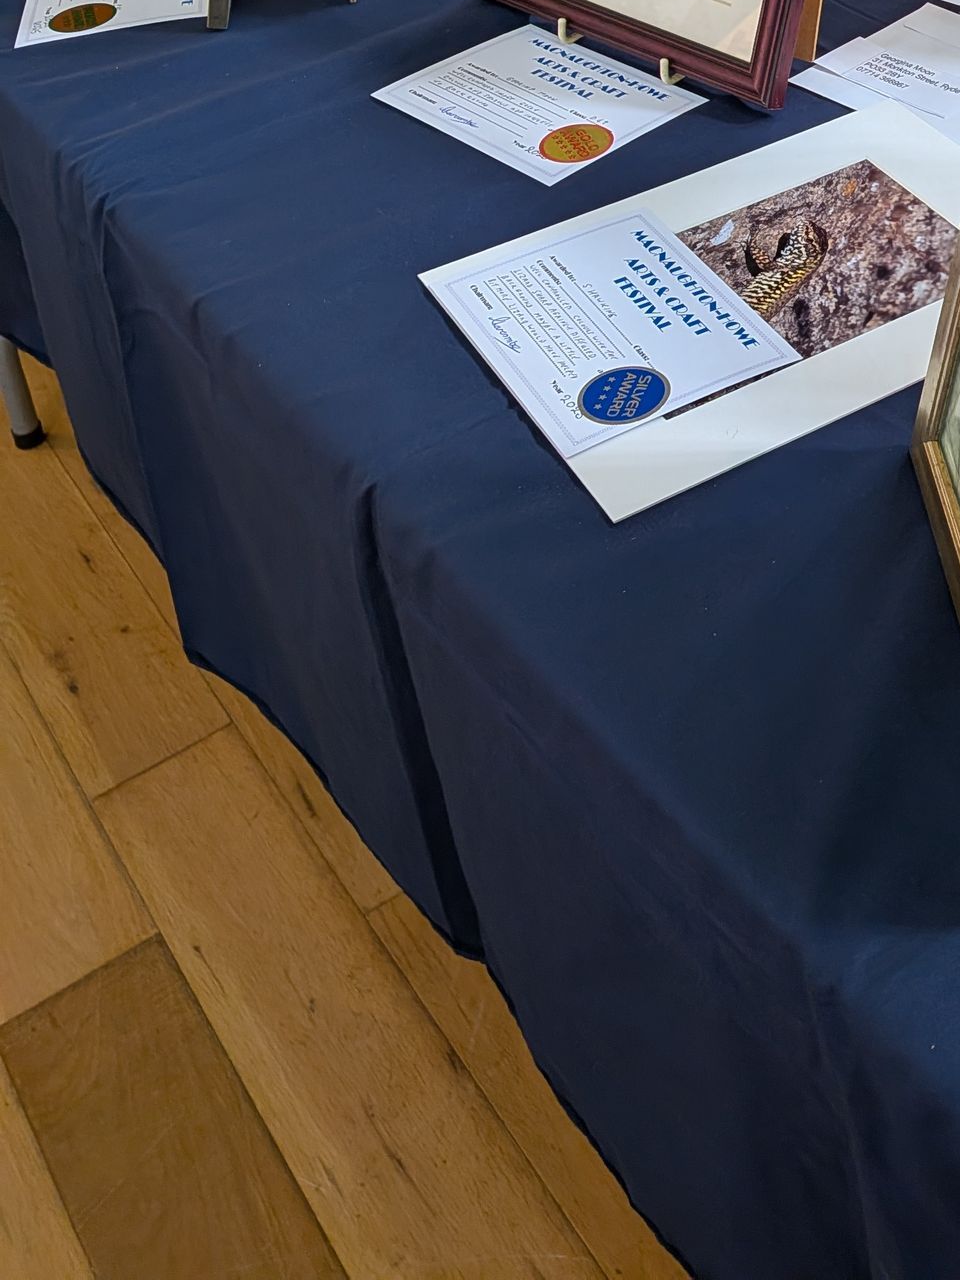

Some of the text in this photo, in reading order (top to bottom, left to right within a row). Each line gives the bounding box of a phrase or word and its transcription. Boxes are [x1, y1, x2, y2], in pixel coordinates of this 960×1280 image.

[530, 69, 595, 99] FESTIVAL
[534, 56, 571, 73] ARTS
[580, 76, 627, 98] CRAFT
[912, 65, 936, 77] Moon
[940, 83, 960, 94] Ryde
[576, 129, 599, 151] GOLD
[613, 276, 671, 332] FESTIVAL
[625, 259, 711, 336] ARTS & CRAFT
[633, 230, 759, 348] MACNAUGHTON-HOWE
[550, 379, 565, 394] Year
[606, 372, 635, 417] AWARD
[621, 375, 652, 418] SILVER
